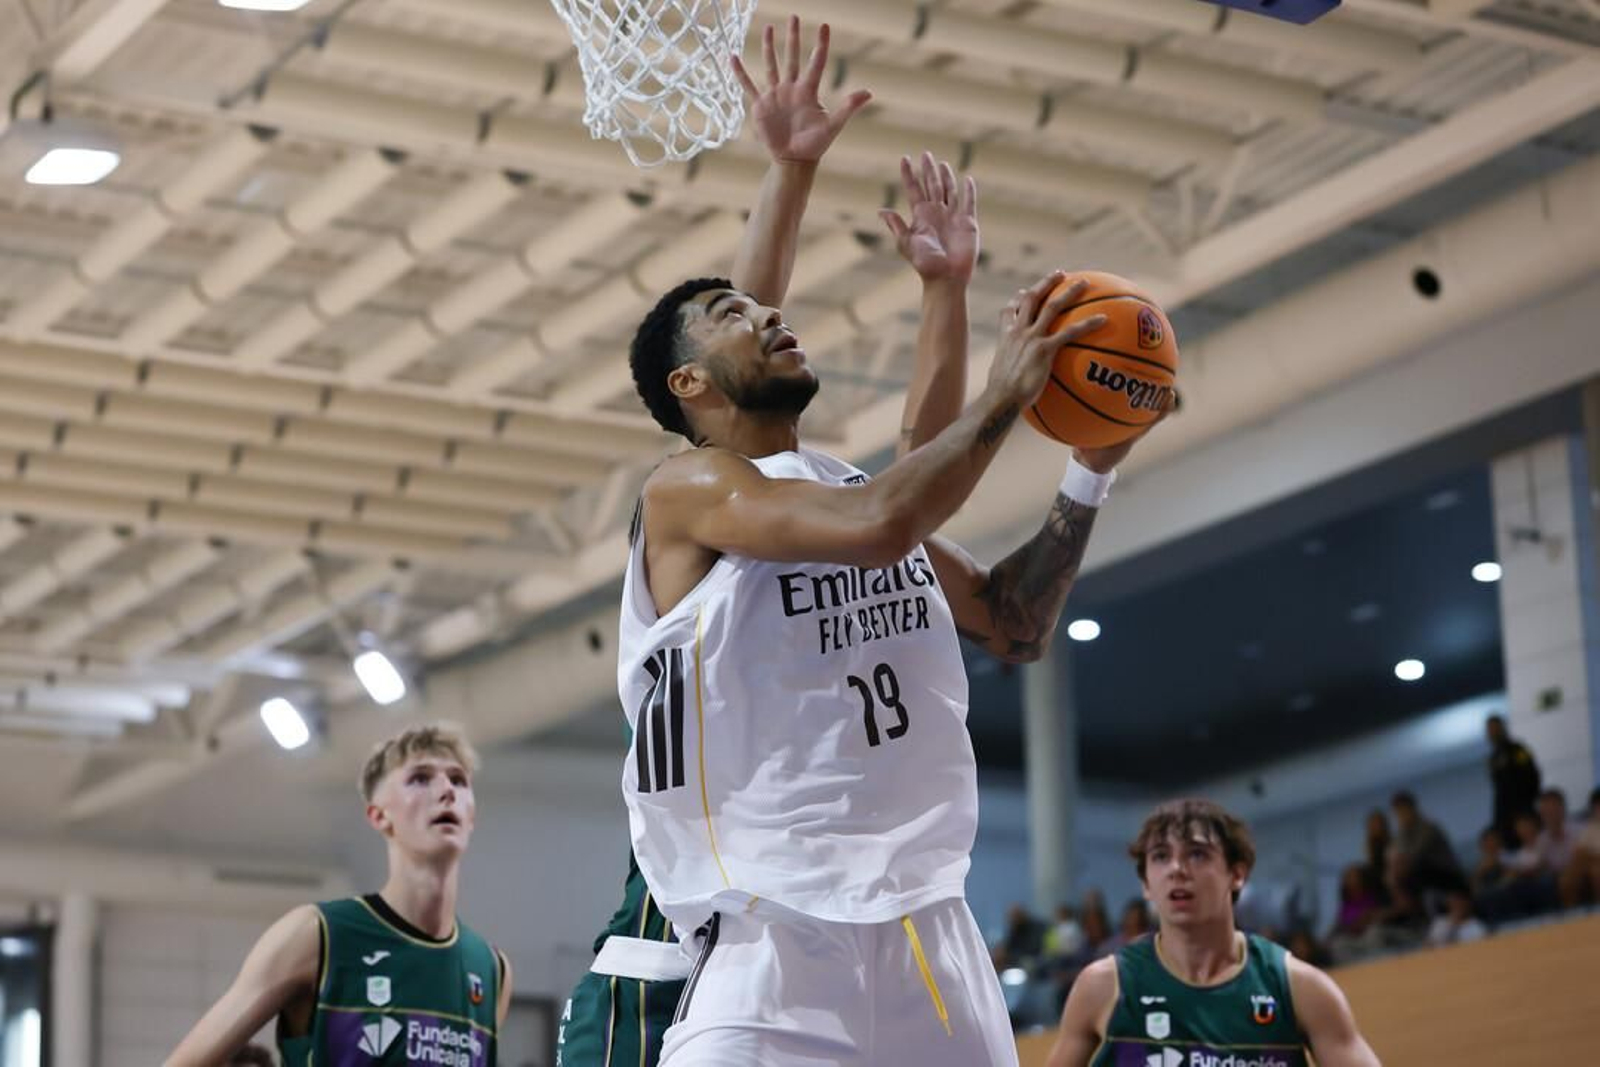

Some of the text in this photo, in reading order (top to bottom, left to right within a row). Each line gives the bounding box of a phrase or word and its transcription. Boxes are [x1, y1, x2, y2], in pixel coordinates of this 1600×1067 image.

[777, 557, 934, 617] Emirates
[819, 597, 930, 654] FLY BETTER
[847, 663, 909, 747] 19
